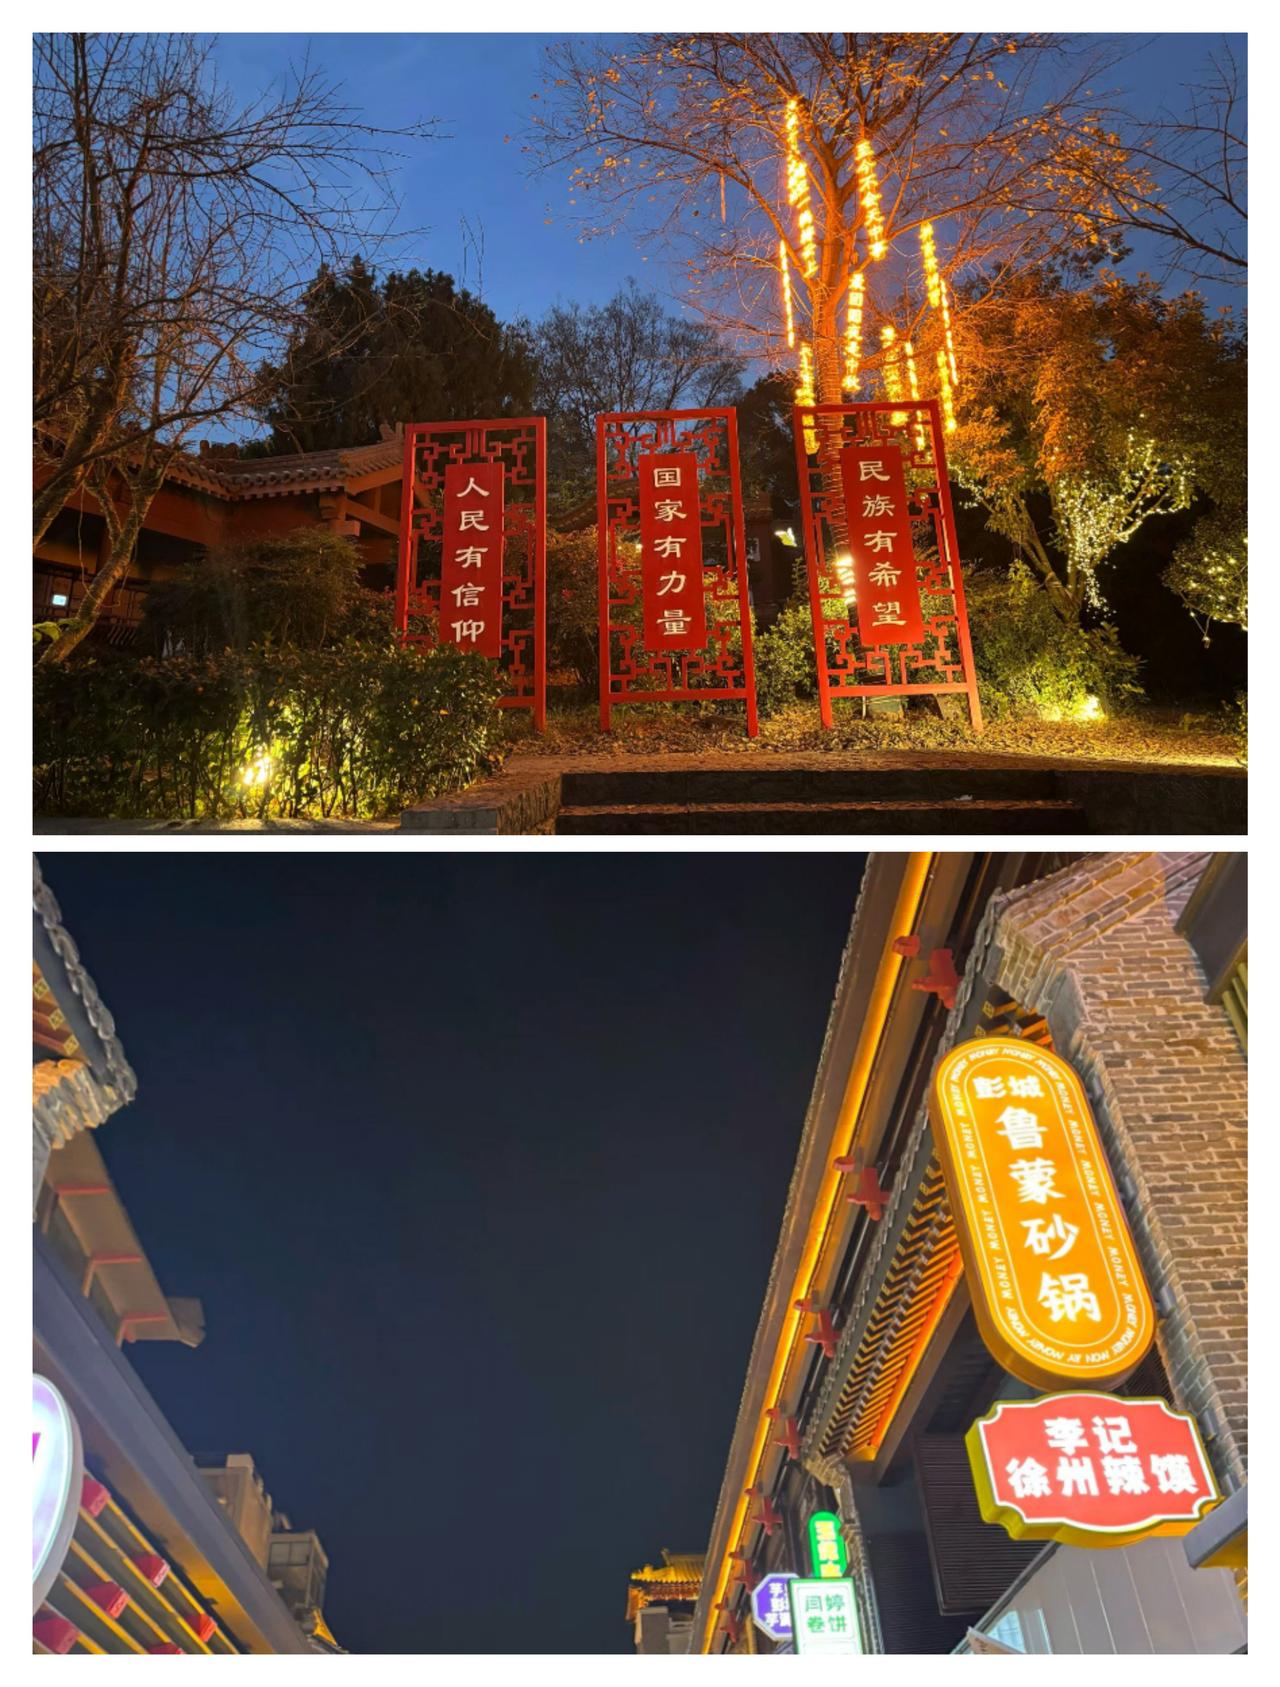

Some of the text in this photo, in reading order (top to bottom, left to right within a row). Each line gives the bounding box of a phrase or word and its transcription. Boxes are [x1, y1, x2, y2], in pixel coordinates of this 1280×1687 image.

[449, 476, 490, 643] 人民有信仰
[653, 466, 691, 636] 国家有力量
[857, 459, 907, 627] 民族有希望
[972, 1075, 1045, 1099] 彭城
[960, 1122, 977, 1159] MONEY
[1068, 1120, 1088, 1155] MONEY
[971, 1165, 989, 1204] MONEY
[1081, 1160, 1101, 1197] MONEY
[982, 1210, 1000, 1250] MONEY
[994, 1105, 1101, 1323] 鲁蒙砂锅
[1094, 1202, 1114, 1240] MONEY
[994, 1257, 1013, 1299] MONEY
[1108, 1246, 1129, 1287] MONEY
[1043, 1416, 1137, 1456] 李记
[1005, 1453, 1199, 1498] 徐州辣馍
[806, 1615, 847, 1633] 卷饼
